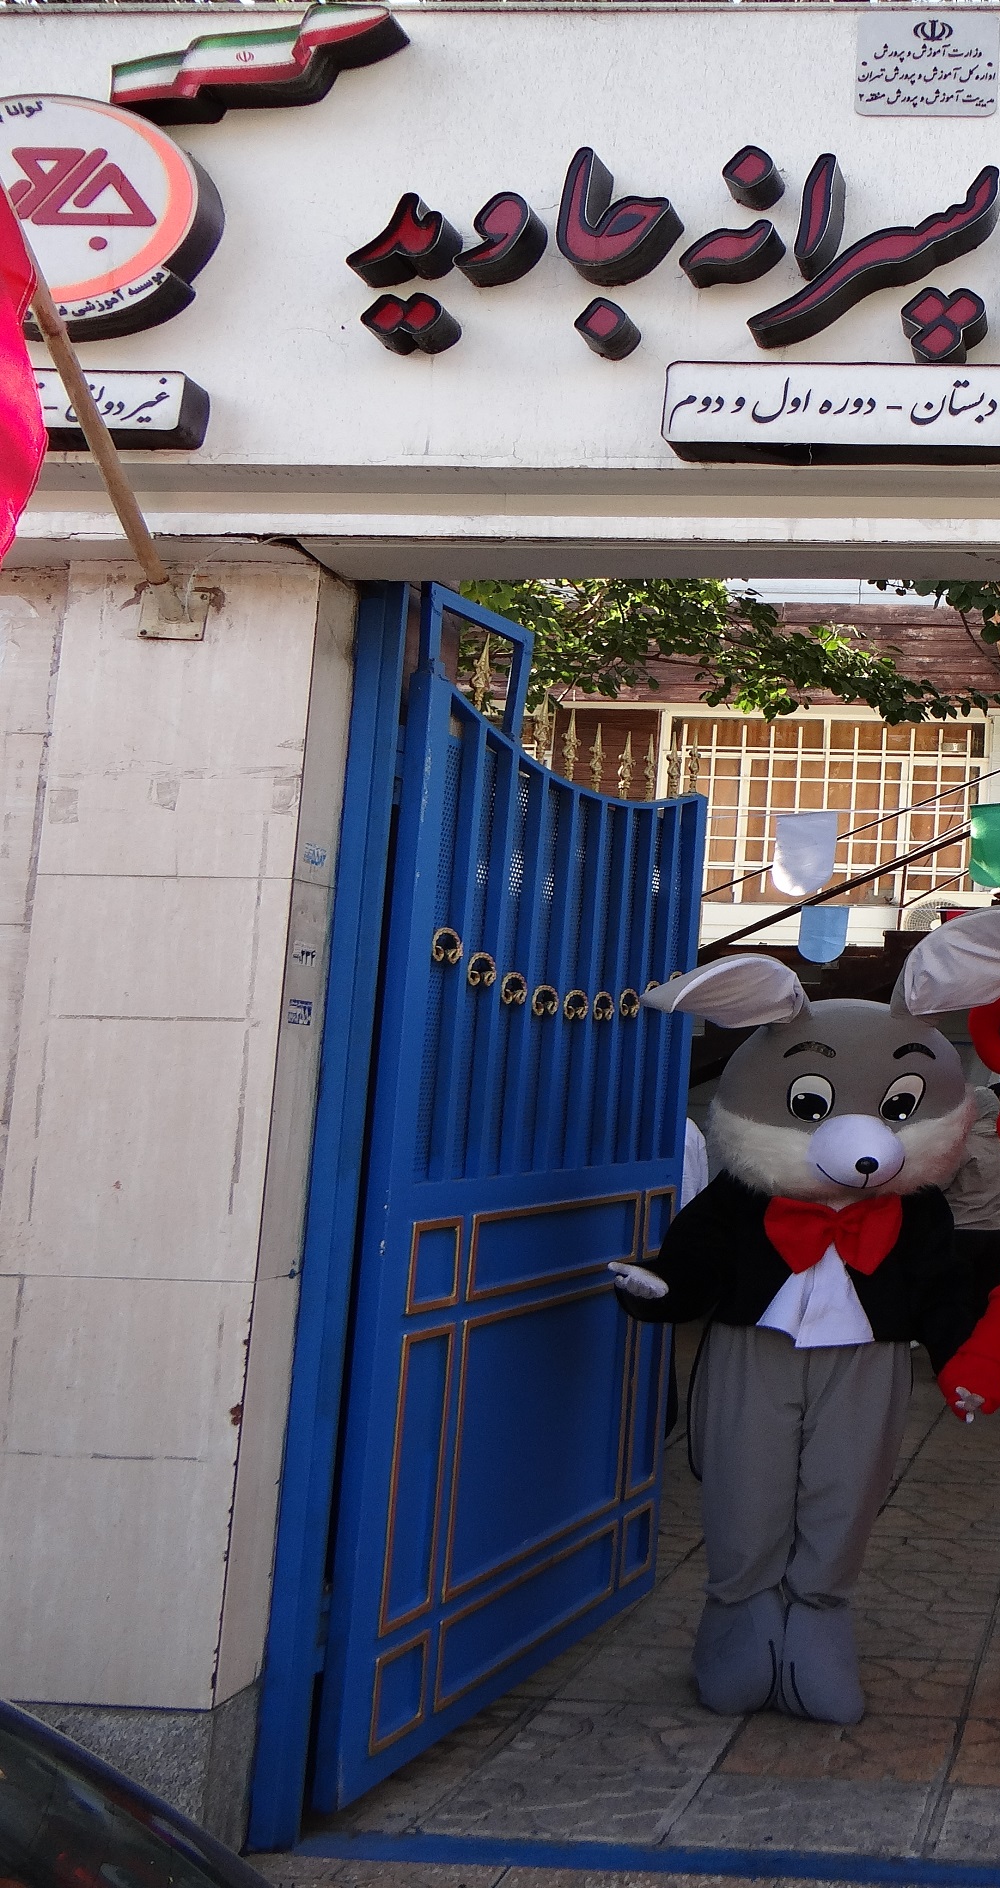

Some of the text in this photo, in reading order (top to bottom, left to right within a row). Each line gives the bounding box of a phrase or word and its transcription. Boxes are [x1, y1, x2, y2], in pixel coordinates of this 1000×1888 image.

[874, 43, 905, 62] پرورش
[913, 44, 951, 59] آموزش
[948, 48, 982, 58] وزارت
[858, 68, 885, 82] تهران
[884, 66, 915, 85] پرورش
[924, 66, 962, 82] آموزش
[959, 65, 979, 82] کل
[975, 71, 996, 81] اداره
[886, 89, 918, 108] پرورش
[926, 89, 964, 105] آموزش
[962, 94, 995, 107] مدیریت
[345, 146, 685, 361] جاوید
[71, 289, 125, 318] آموزشی
[730, 397, 745, 414] و
[751, 376, 811, 424] اول
[818, 398, 876, 416] دوره
[910, 379, 997, 426] دبستان
[668, 394, 724, 434] دوم
